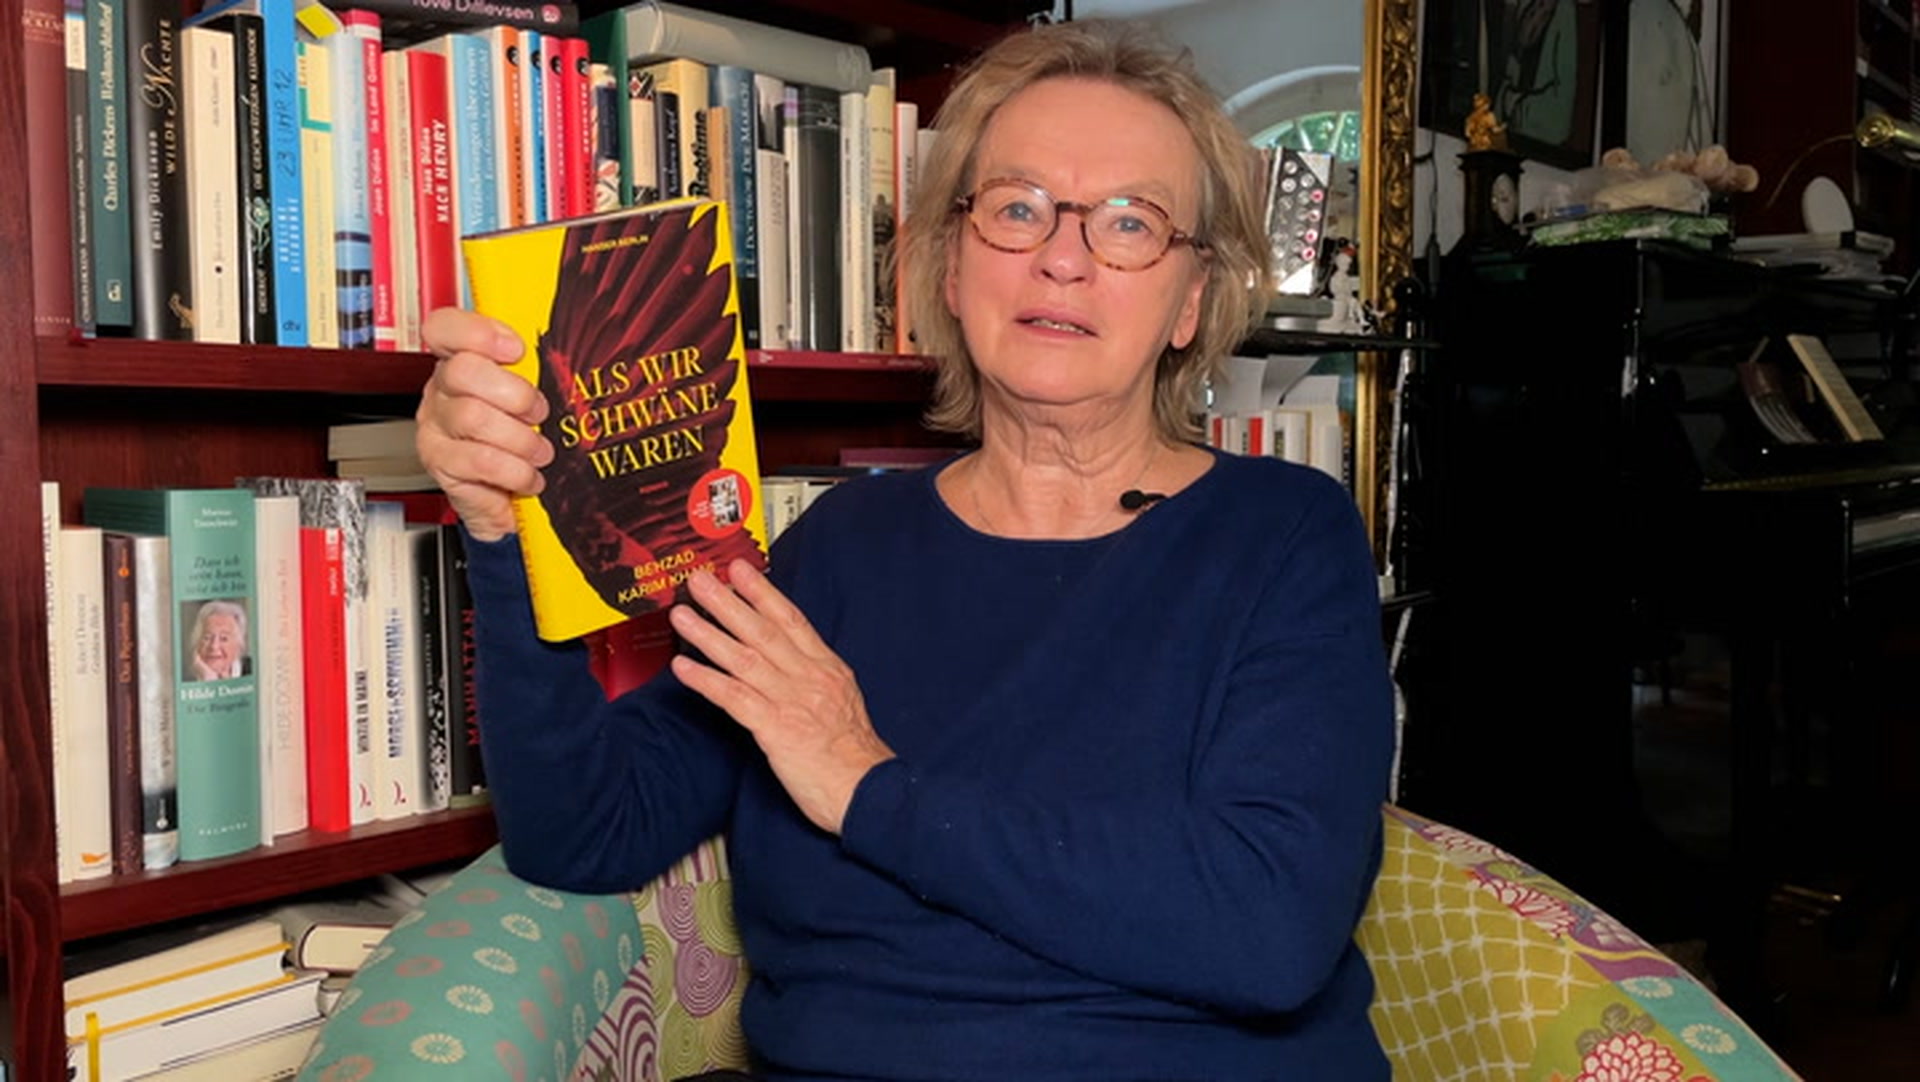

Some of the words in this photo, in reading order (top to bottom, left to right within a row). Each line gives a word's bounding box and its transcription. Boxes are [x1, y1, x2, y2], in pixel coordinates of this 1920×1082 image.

[270, 68, 293, 92] 12
[102, 105, 117, 158] Dickens
[163, 120, 177, 175] WILDE
[431, 118, 448, 180] HENRY
[102, 161, 119, 211] Charles
[147, 130, 161, 204] Dickinson
[276, 150, 296, 178] 23
[150, 210, 165, 250] Emily
[569, 361, 633, 404] ALS
[637, 346, 704, 385] WIR
[560, 382, 719, 448] SCHWÄNE
[588, 425, 704, 479] WAREN
[617, 577, 667, 603] KARIM
[634, 549, 696, 579] BEHZAD
[180, 687, 216, 701] Hilde
[218, 683, 255, 698] Domin
[461, 607, 481, 747] MANHATTAN
